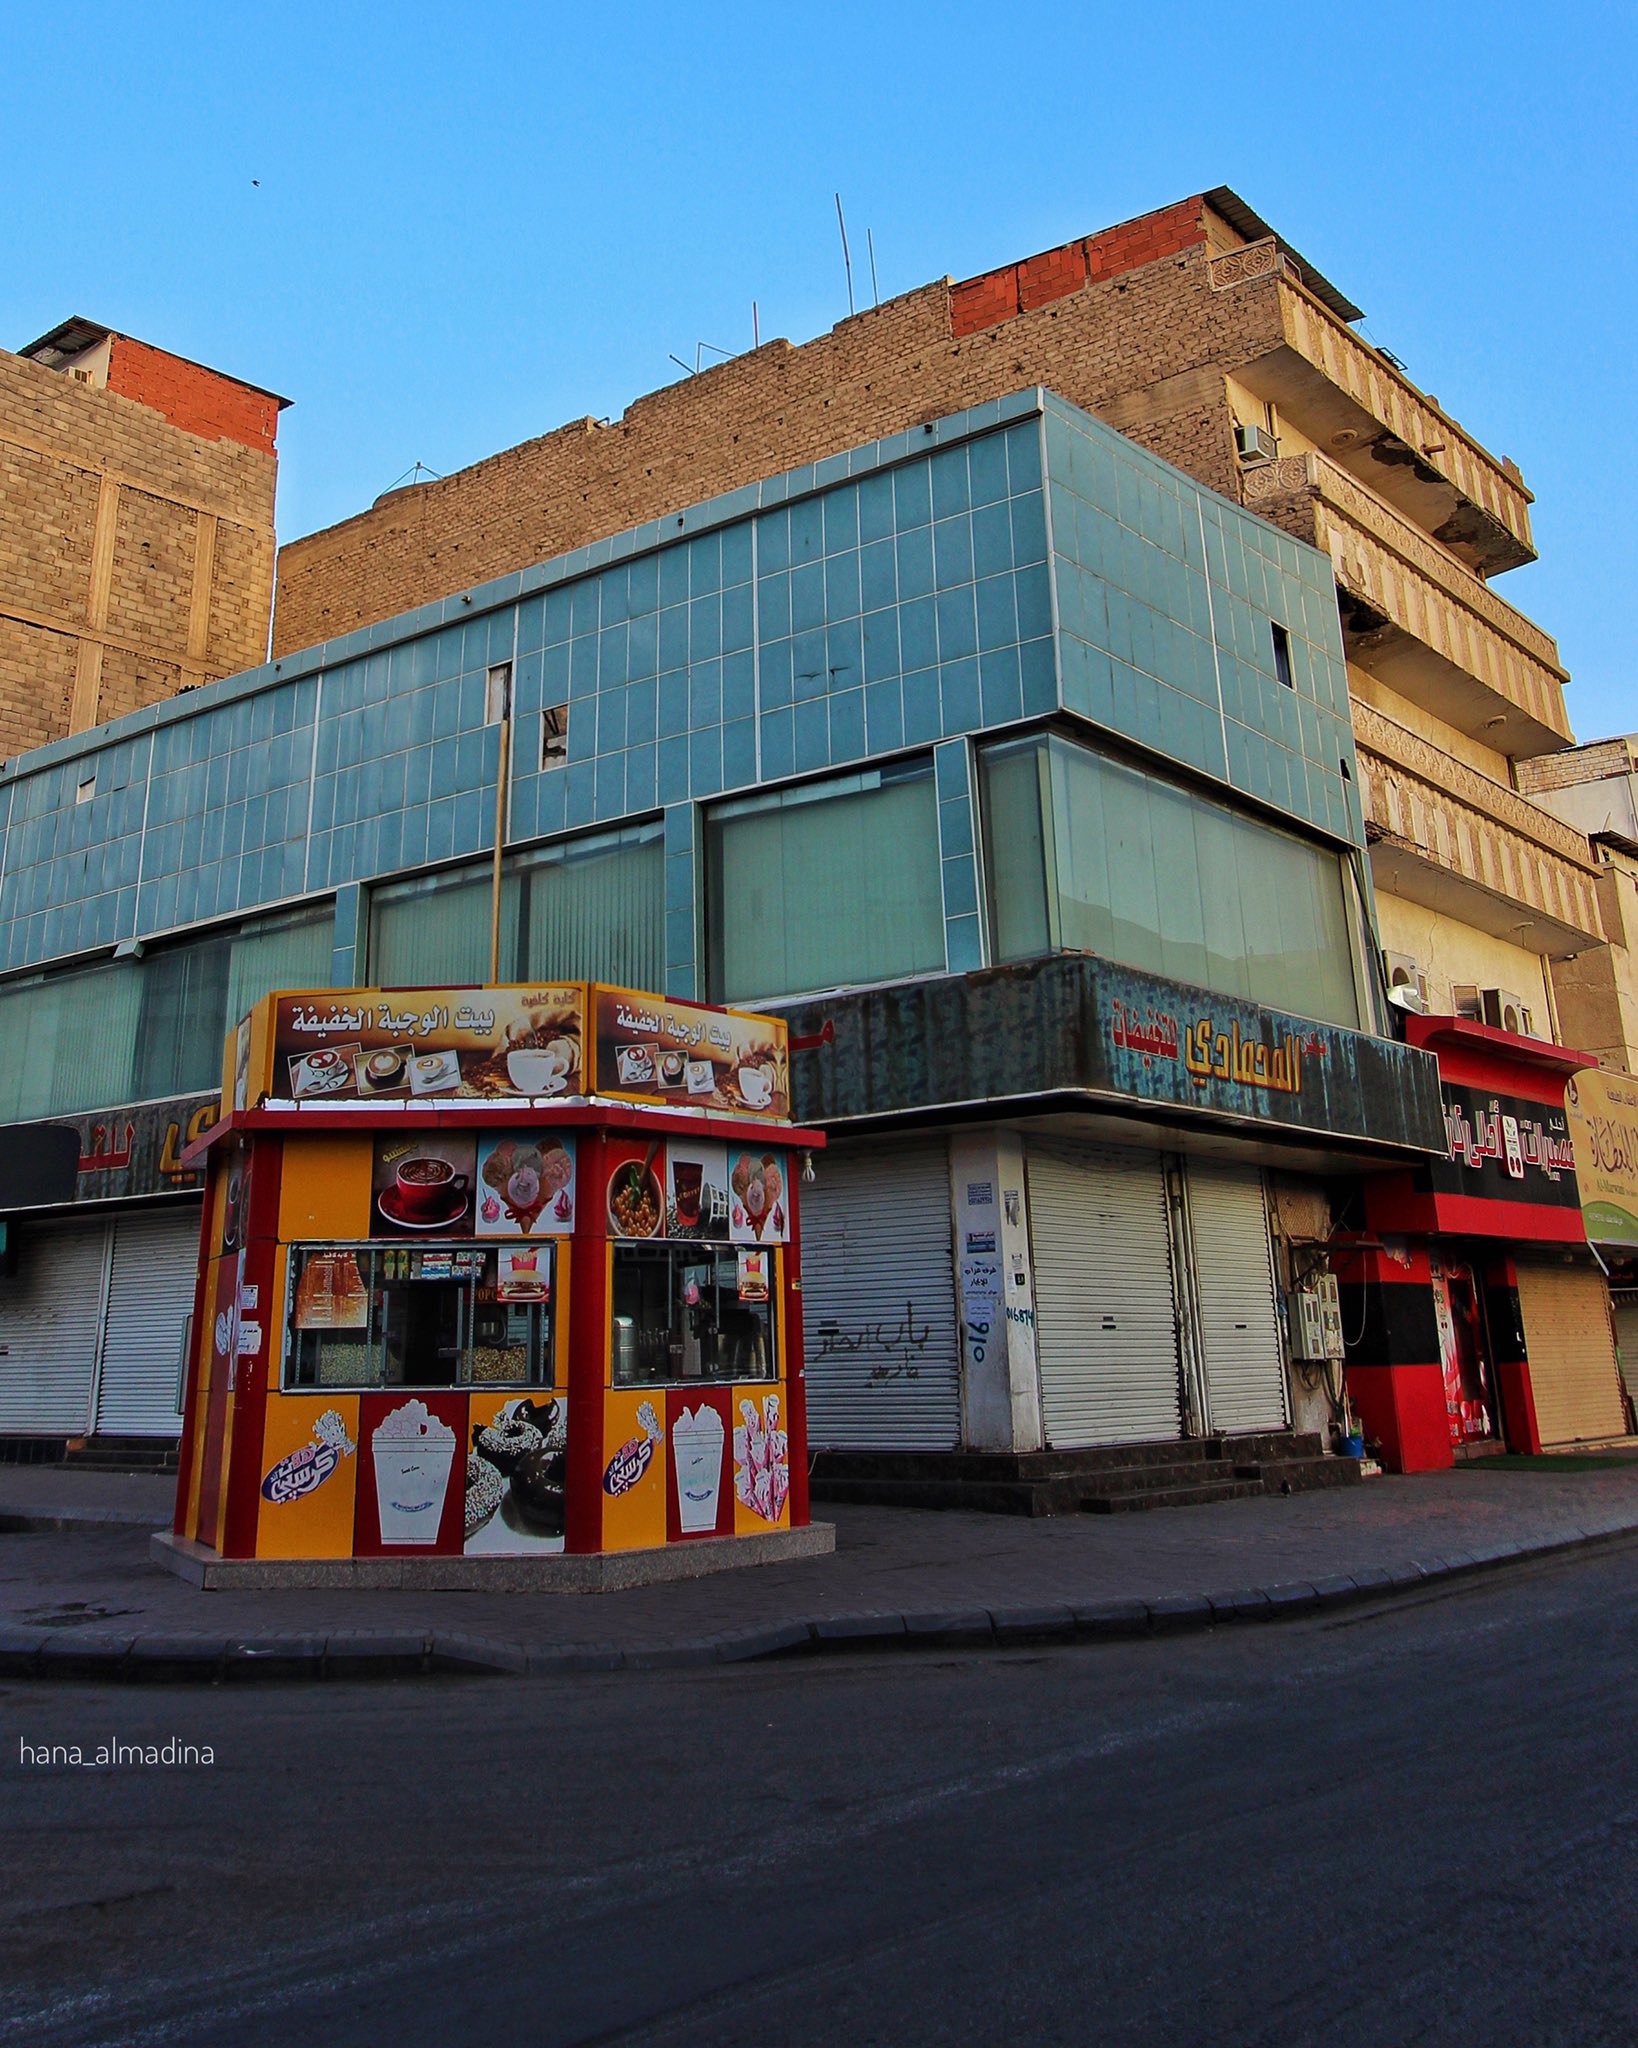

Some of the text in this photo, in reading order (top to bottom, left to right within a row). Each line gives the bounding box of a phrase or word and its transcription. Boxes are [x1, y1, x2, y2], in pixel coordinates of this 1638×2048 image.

[291, 1003, 495, 1039] بيت الوجبة الخفيفة
[615, 1004, 733, 1052] بيت الوجبة الخفيفة
[1111, 997, 1178, 1071] للتخفيضات
[1185, 1018, 1301, 1096] المحمادي
[1464, 1100, 1503, 1169] أحلى
